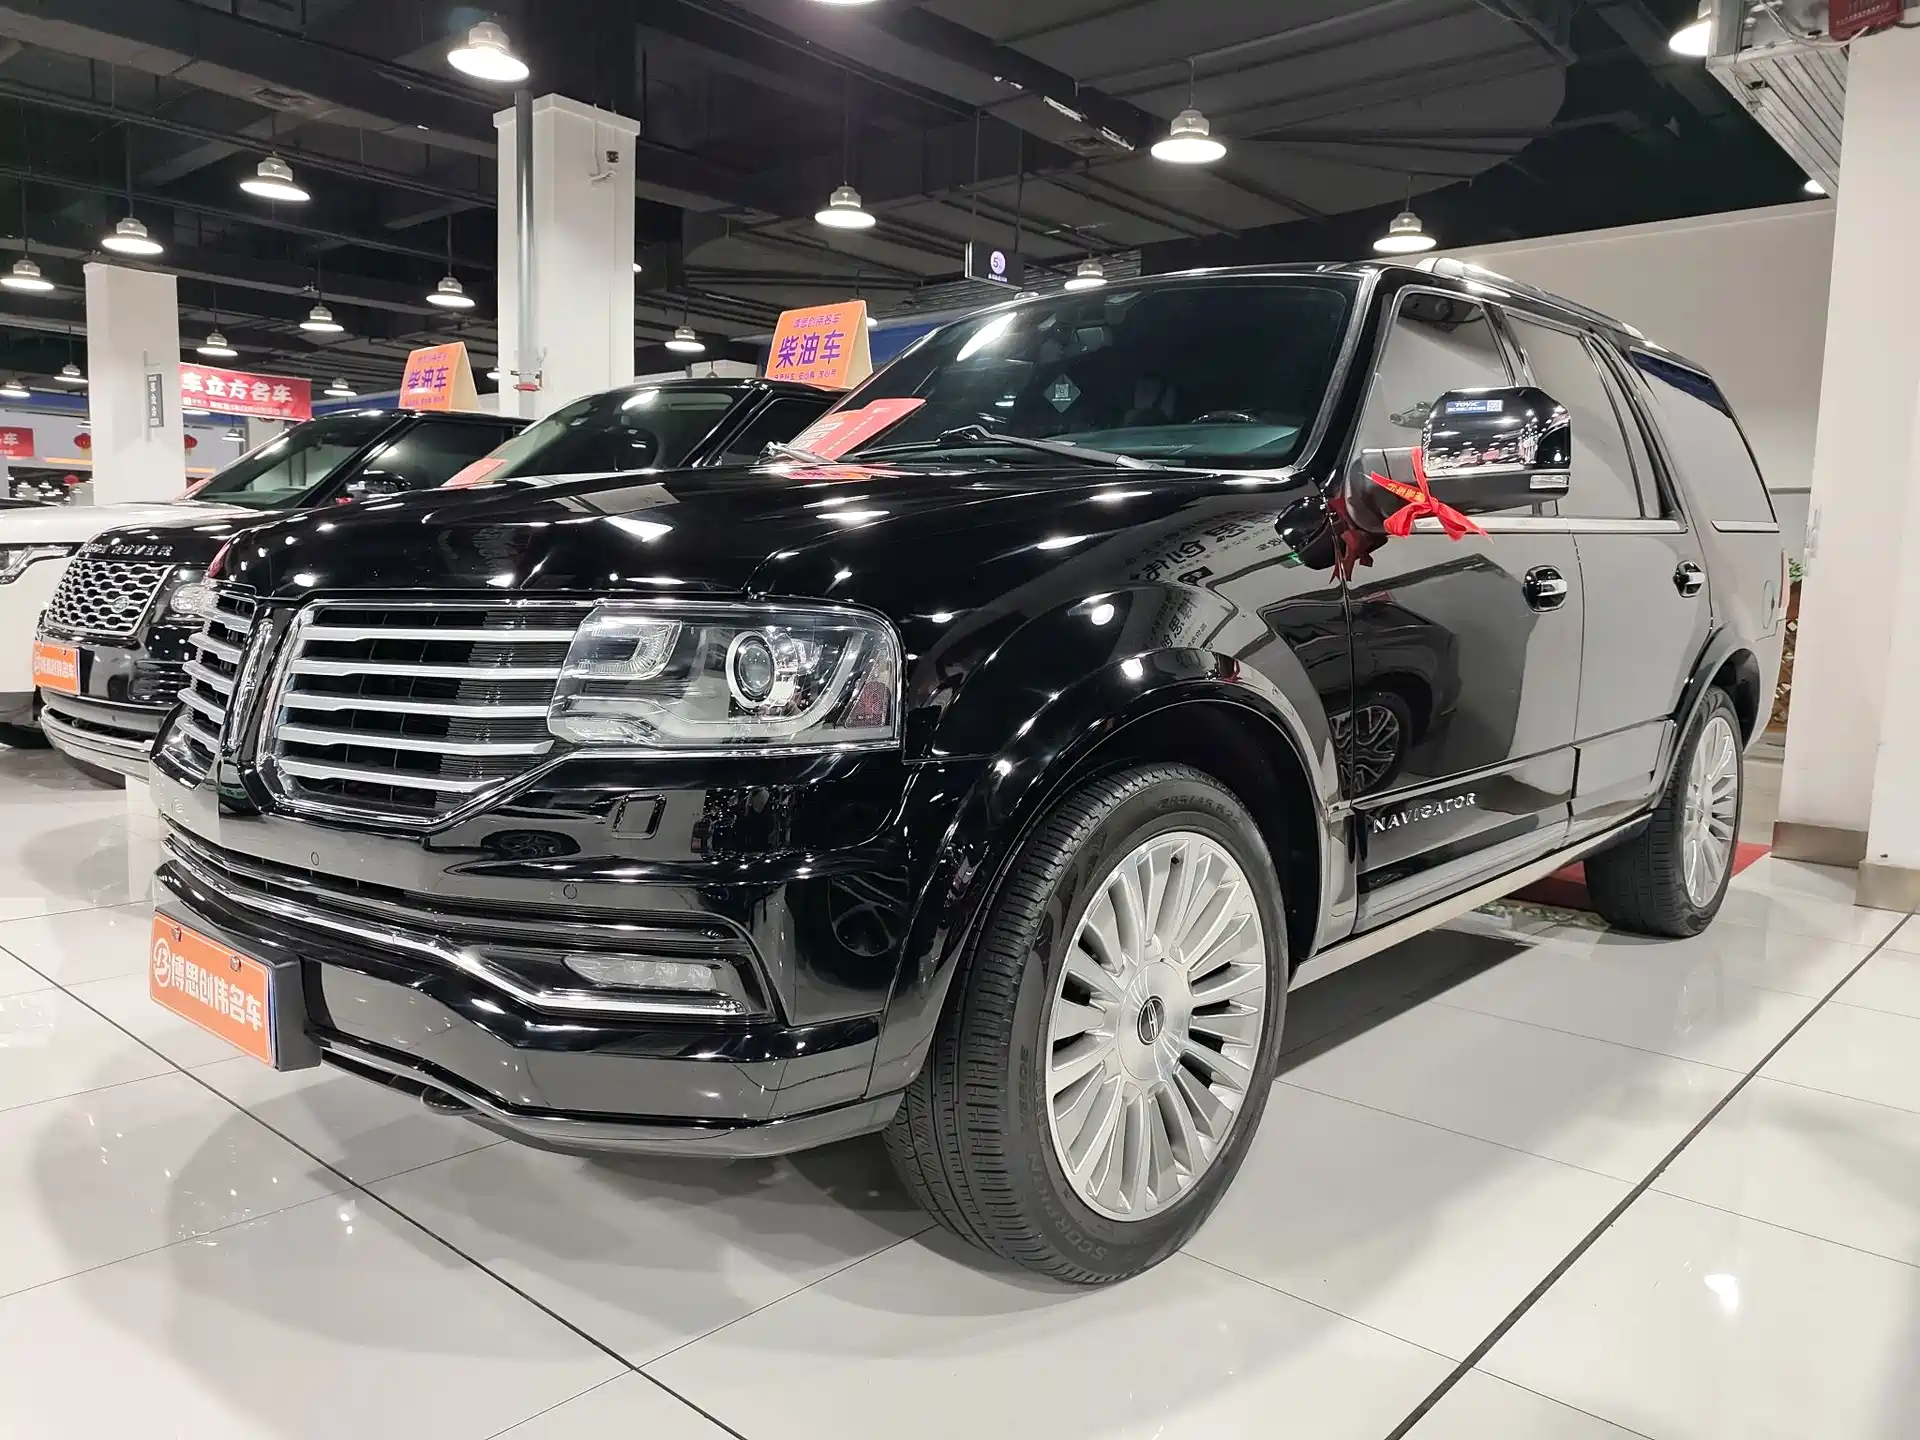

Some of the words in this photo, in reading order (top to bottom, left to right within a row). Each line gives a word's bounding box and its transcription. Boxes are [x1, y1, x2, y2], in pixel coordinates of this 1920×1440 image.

[775, 329, 845, 369] 柴油车
[181, 372, 293, 404] 车立方名车
[1373, 792, 1477, 834] NAVIGATOR
